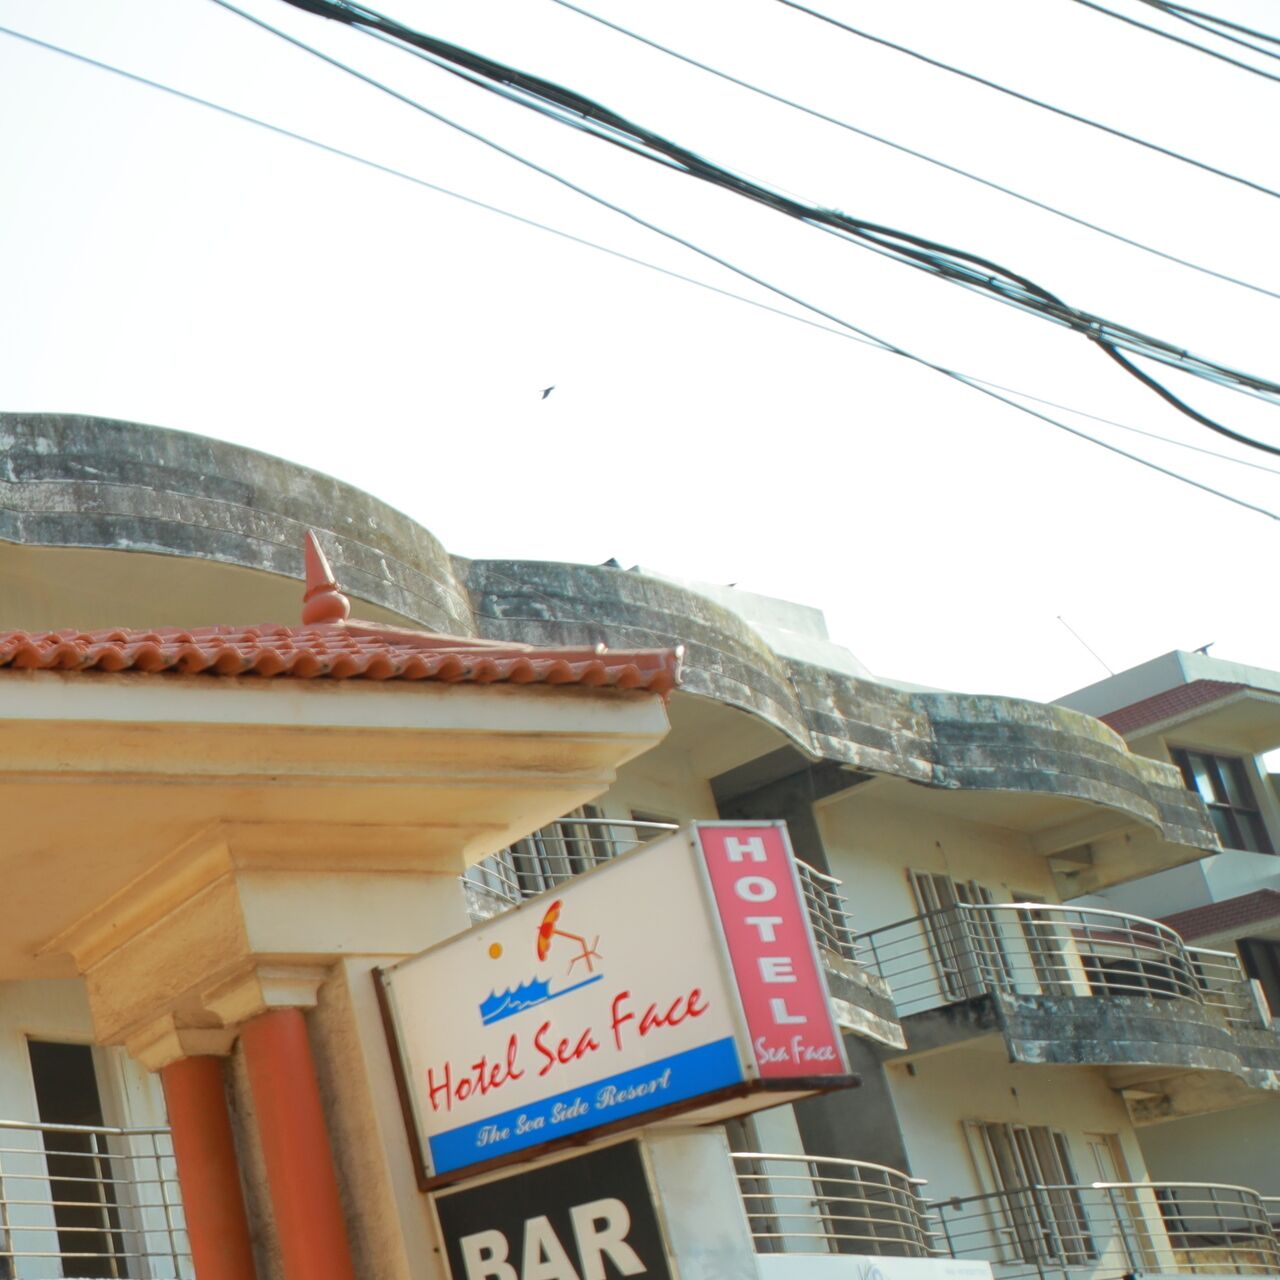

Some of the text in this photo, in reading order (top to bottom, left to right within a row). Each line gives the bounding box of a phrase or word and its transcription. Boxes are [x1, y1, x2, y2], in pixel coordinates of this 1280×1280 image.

[723, 836, 808, 1025] HOTEL
[427, 988, 710, 1112] Hotel Sea Face
[754, 1034, 837, 1065] Sea Face
[476, 1068, 672, 1148] The Sea Side Resort
